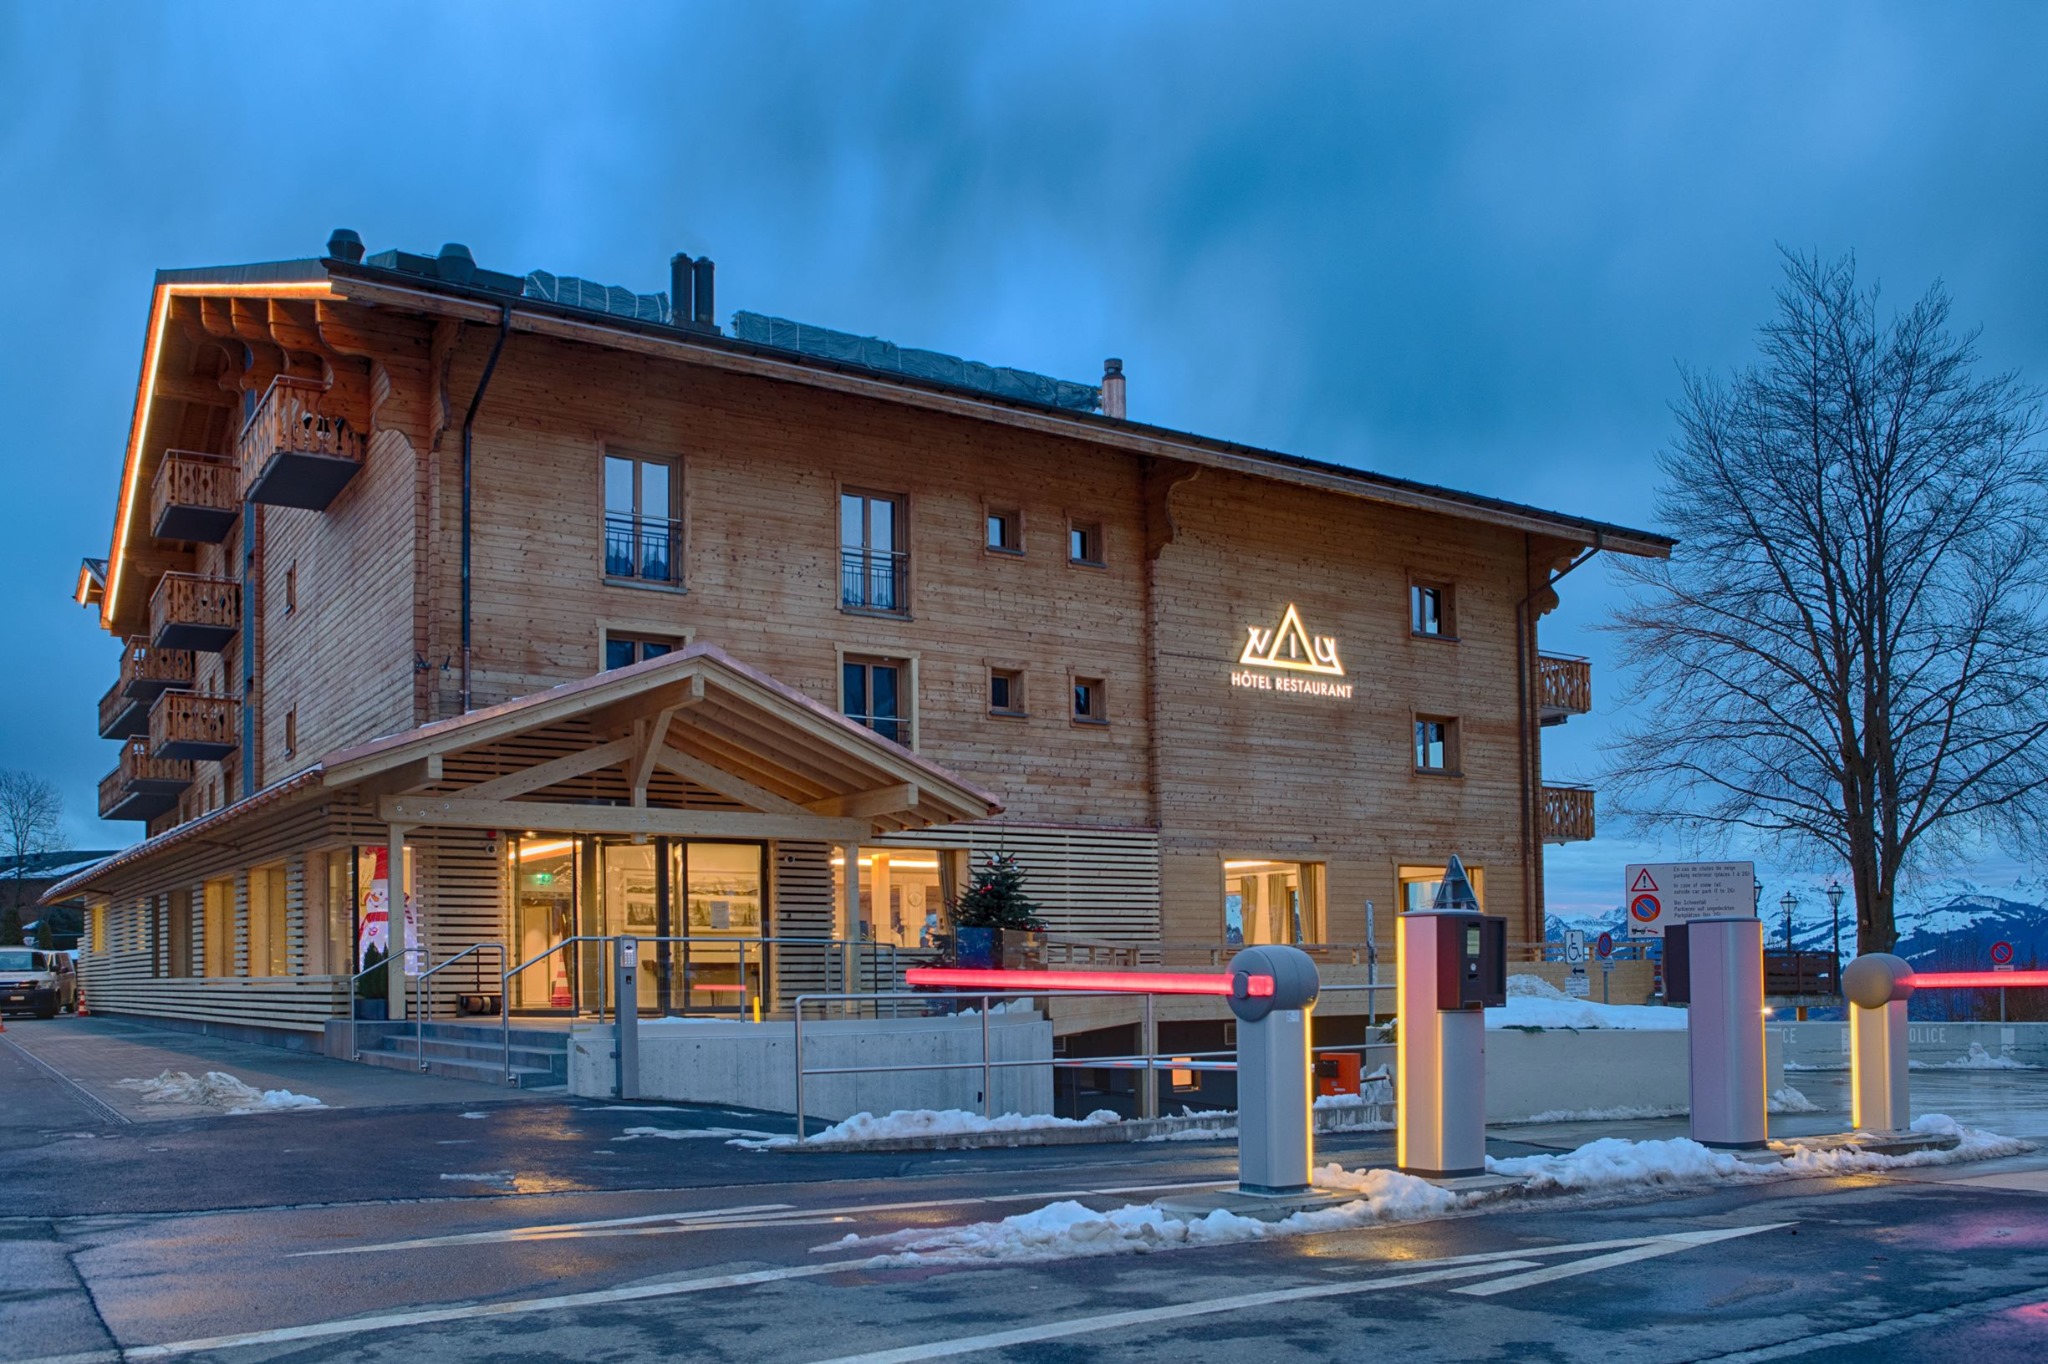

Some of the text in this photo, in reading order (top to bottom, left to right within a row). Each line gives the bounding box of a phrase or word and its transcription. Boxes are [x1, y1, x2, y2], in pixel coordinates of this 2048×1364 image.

[1231, 670, 1353, 699] HÔTEL RESTAURANT
[1908, 1027, 1947, 1043] OLICE
